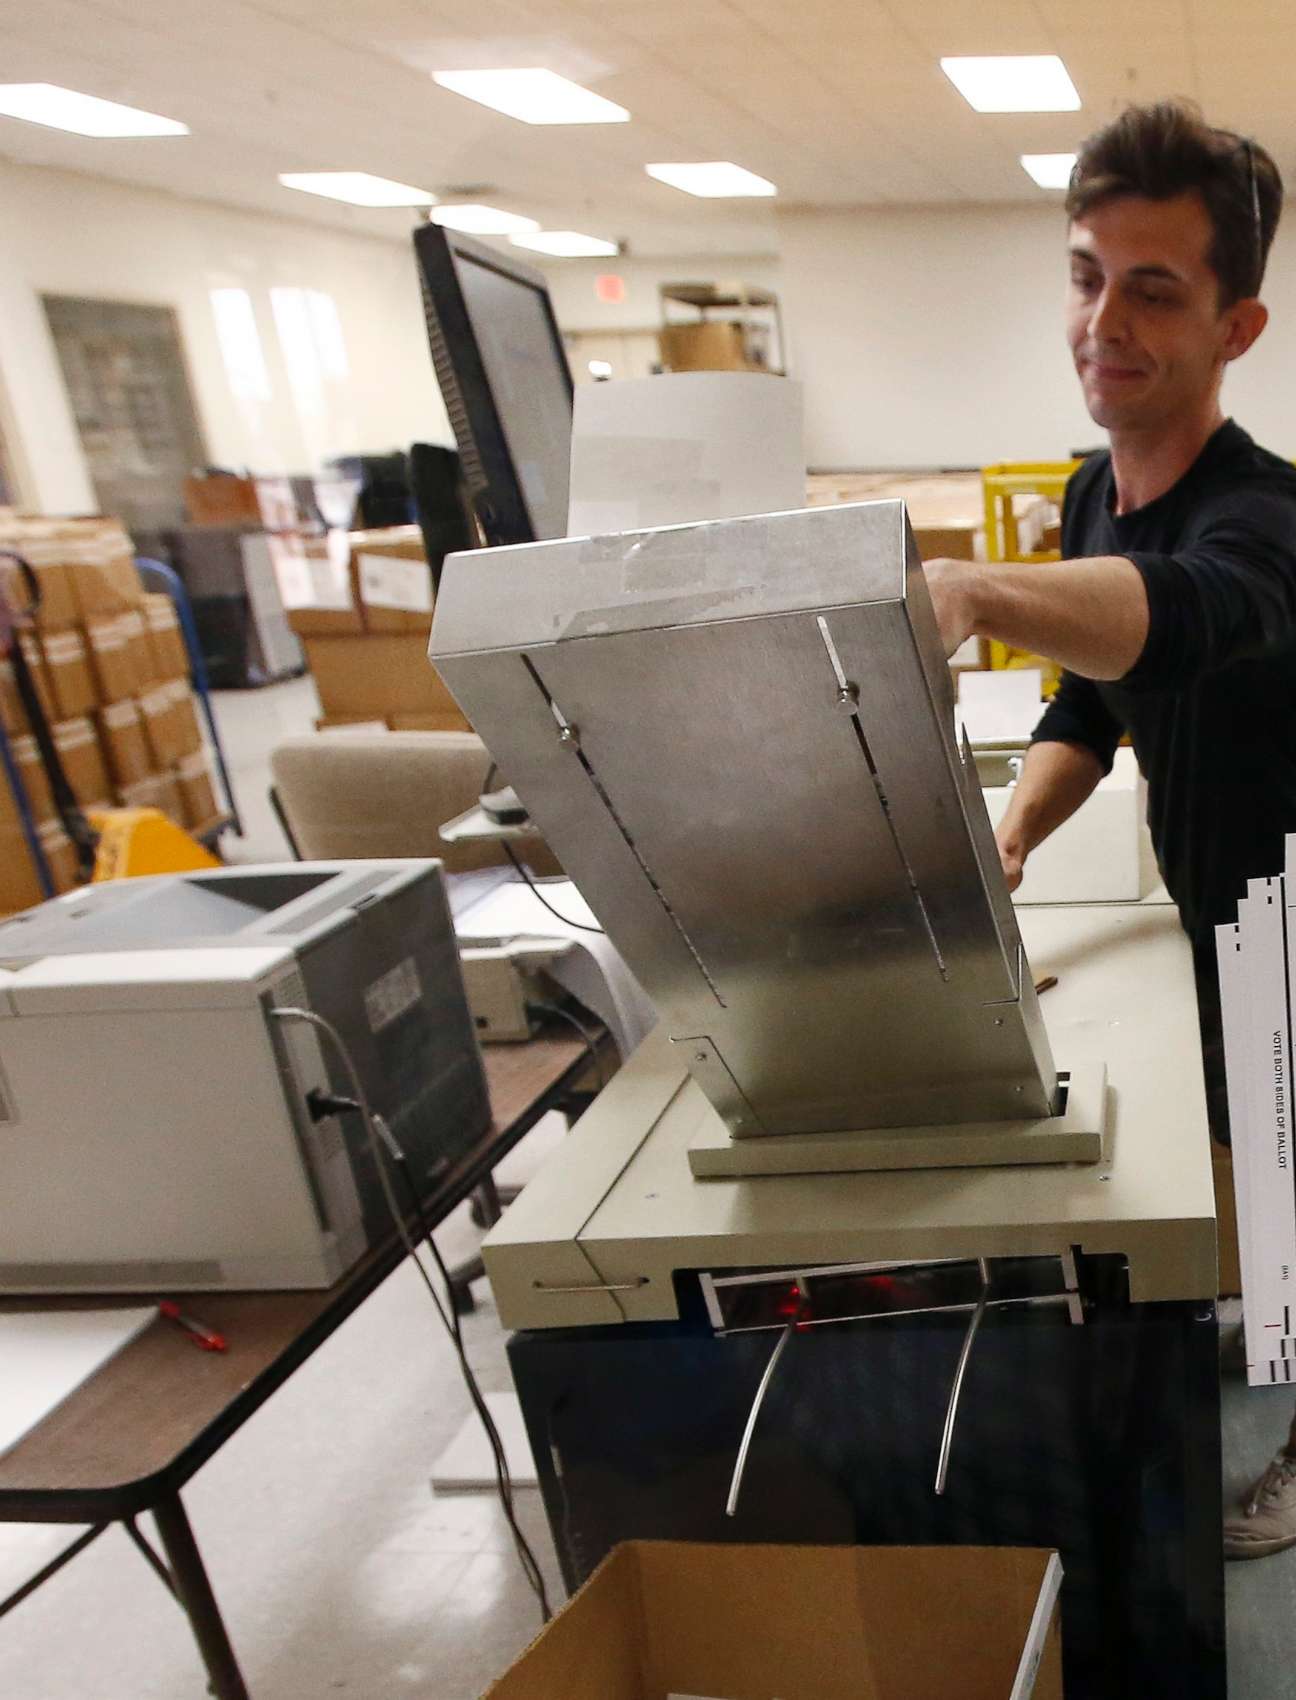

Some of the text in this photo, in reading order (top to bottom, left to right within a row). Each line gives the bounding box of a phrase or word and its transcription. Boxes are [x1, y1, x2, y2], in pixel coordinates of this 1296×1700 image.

[1272, 1030, 1282, 1056] VOTE
[1273, 1057, 1283, 1084] BOTH
[1274, 1085, 1284, 1114] SIDES
[1276, 1130, 1286, 1169] BALLOT
